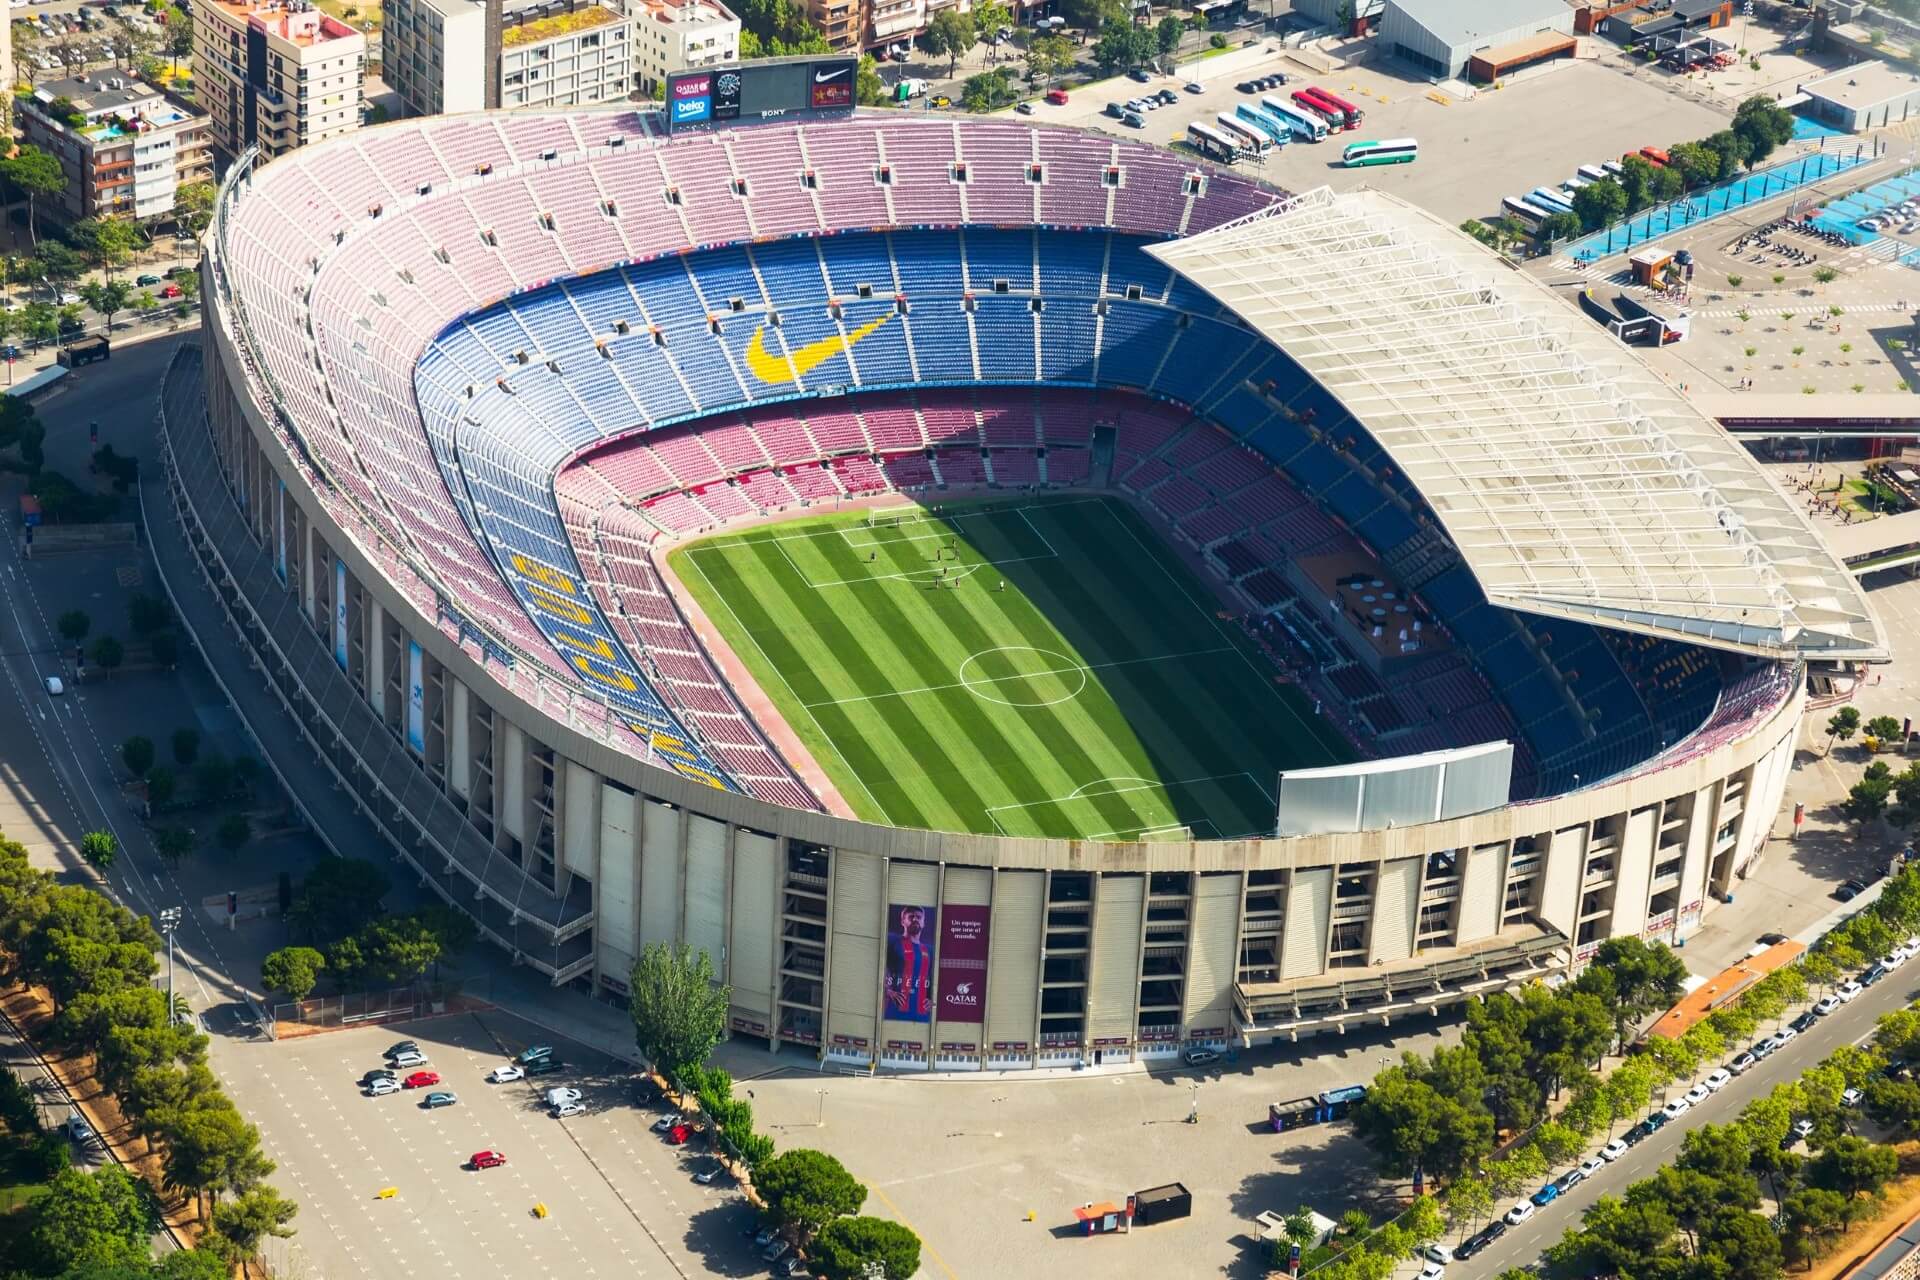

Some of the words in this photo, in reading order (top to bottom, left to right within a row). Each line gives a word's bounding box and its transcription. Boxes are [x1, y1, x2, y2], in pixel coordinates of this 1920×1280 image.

[678, 100, 704, 112] beko
[961, 920, 981, 928] equipo
[946, 994, 977, 1003] QATAR
